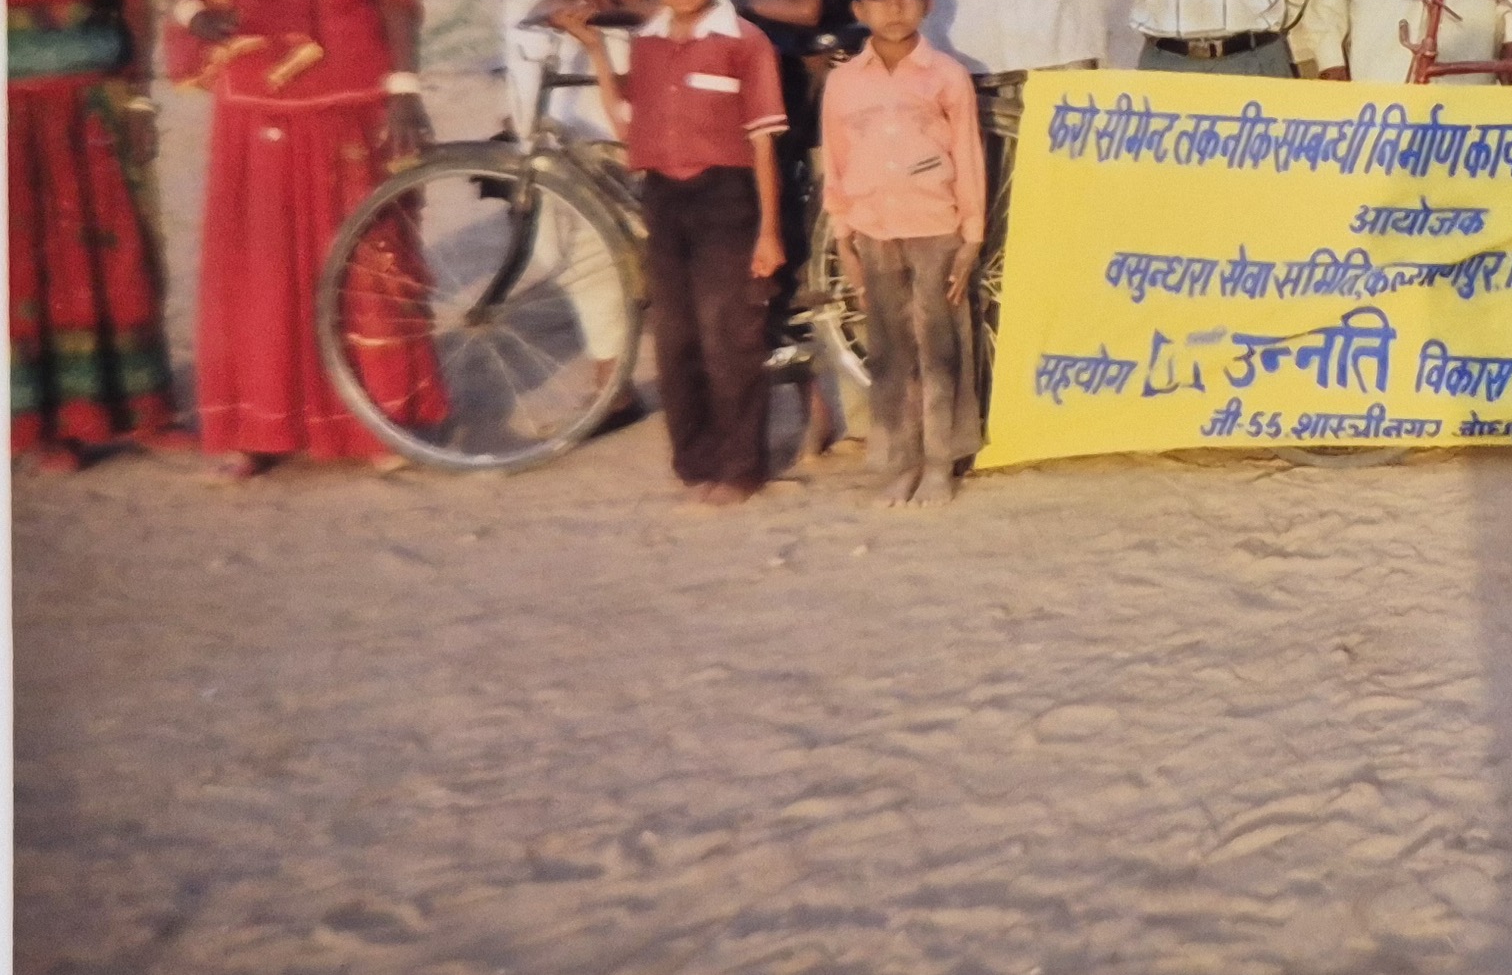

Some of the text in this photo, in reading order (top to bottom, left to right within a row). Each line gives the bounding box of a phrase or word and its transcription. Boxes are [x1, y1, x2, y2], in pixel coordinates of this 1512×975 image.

[1174, 100, 1278, 169] तकनीक
[1364, 103, 1472, 178] निर्माण
[1349, 194, 1490, 237] आयोजक
[1105, 251, 1219, 304] वसुन्धरा
[1220, 243, 1277, 300] सेवा
[1034, 342, 1139, 405] सहयोग
[1223, 306, 1398, 394] उन्नति
